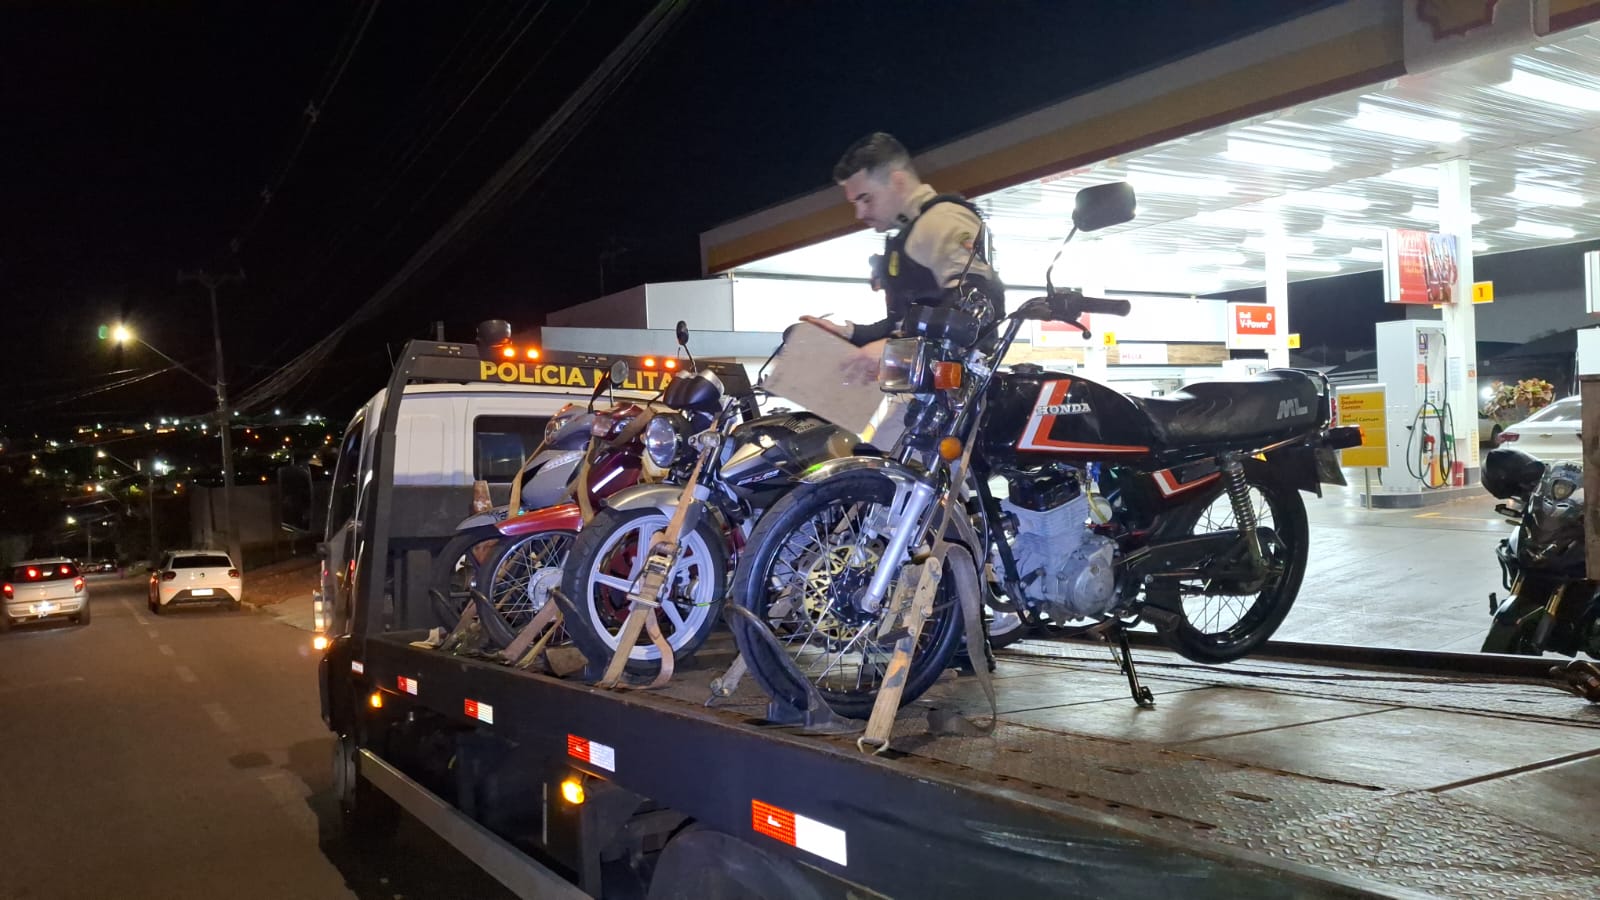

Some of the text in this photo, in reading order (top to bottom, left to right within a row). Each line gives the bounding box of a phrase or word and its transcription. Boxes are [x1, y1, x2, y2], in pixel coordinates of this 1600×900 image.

[1239, 319, 1270, 329] V-Power
[593, 367, 673, 391] LITA
[1036, 402, 1092, 416] HONDA
[1276, 397, 1309, 420] ML
